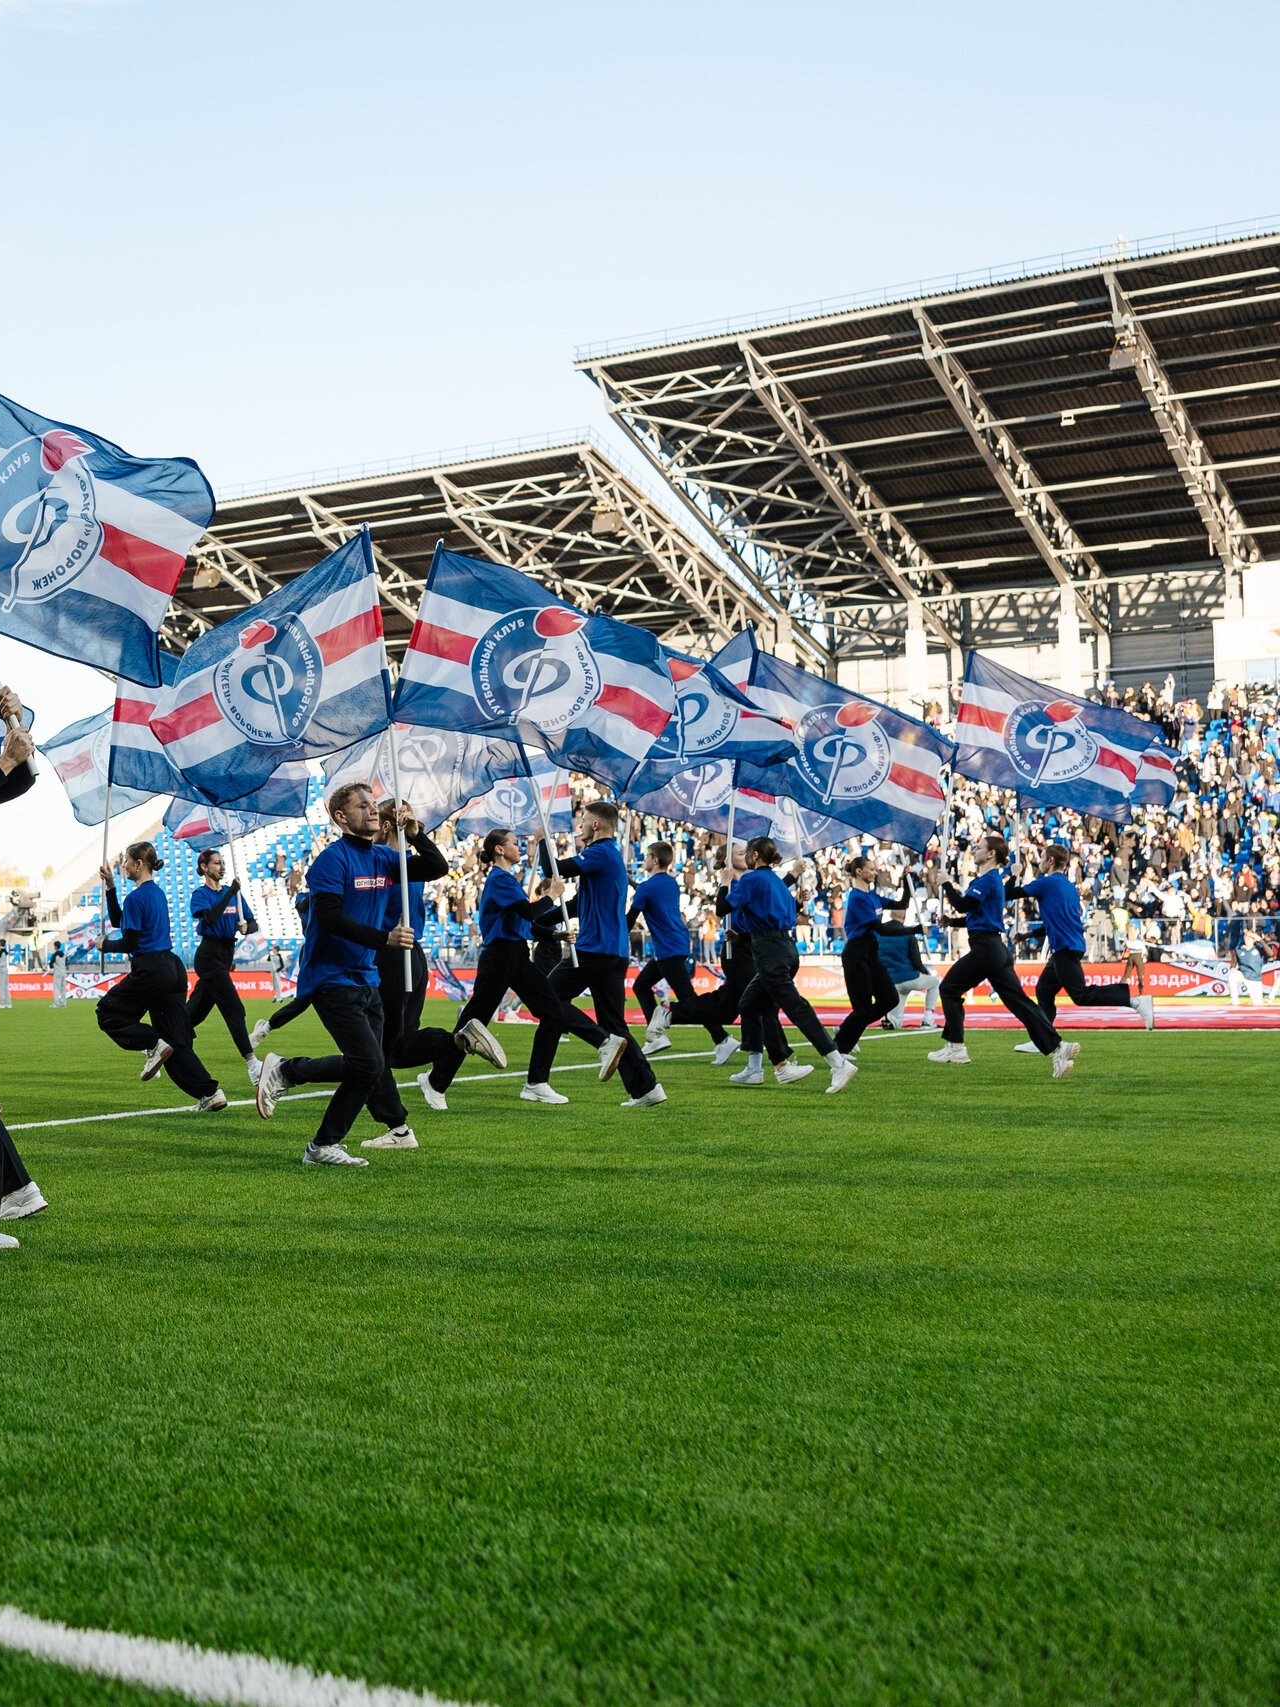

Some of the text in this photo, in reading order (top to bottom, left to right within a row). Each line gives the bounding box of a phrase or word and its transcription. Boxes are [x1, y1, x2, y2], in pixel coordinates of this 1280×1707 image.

[32, 539, 89, 591] ВОРОНЕЖ
[493, 618, 525, 642] КЛУБ
[697, 712, 731, 746] ВОРОНЕЖ
[844, 770, 881, 793] ВОРОНЕЖ
[1148, 973, 1201, 990] задач
